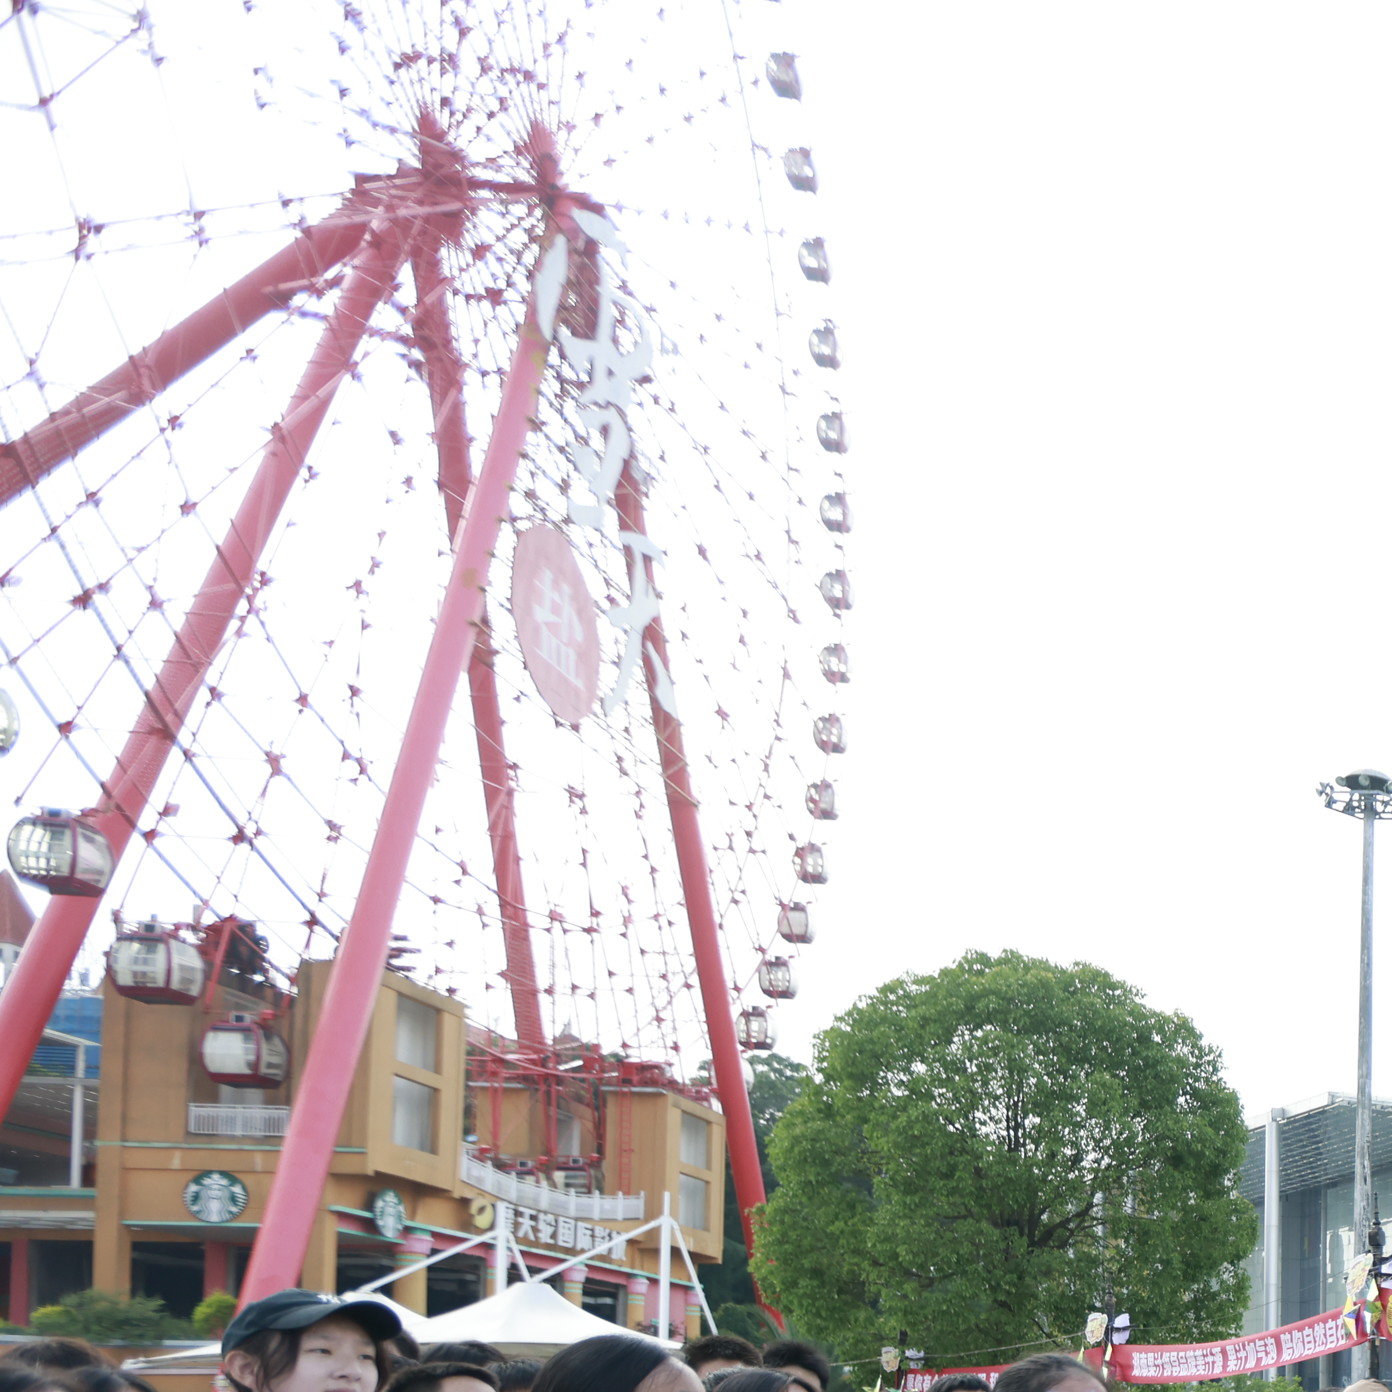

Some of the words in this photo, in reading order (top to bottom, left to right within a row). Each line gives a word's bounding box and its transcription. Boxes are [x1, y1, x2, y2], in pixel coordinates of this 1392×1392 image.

[1226, 1336, 1278, 1373] 果汁加气泡
